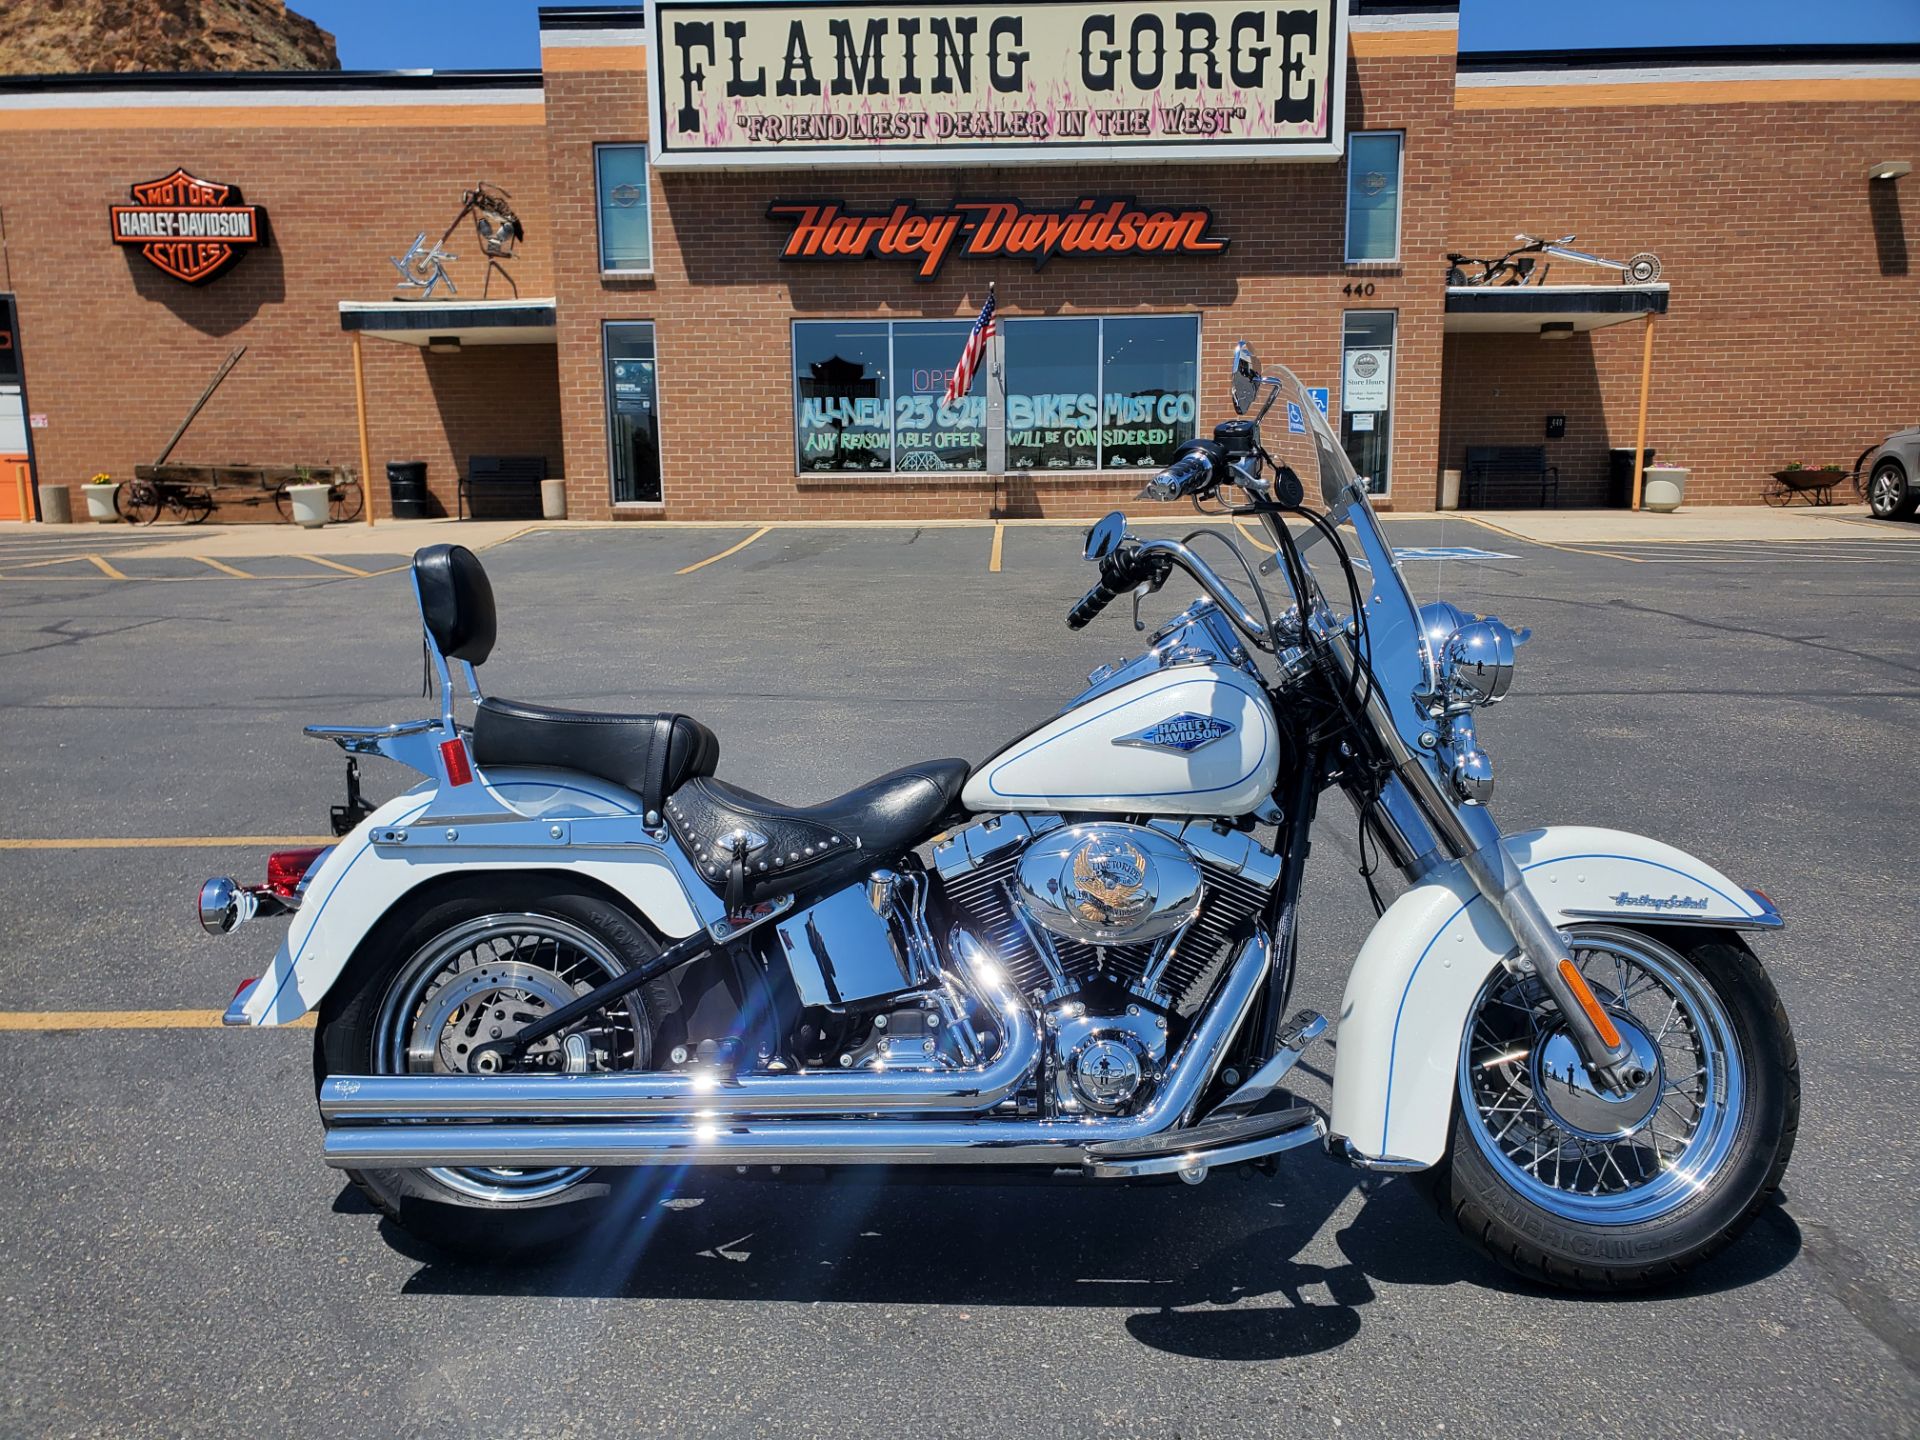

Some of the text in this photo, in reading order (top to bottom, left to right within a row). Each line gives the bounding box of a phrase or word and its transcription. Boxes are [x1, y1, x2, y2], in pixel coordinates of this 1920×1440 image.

[673, 9, 1319, 134] FLAMING GORGE
[736, 102, 1247, 144] "FRIENDLIEST DEALER IN THE WEST"
[147, 177, 218, 206] MOTOR
[118, 212, 250, 237] HARLEY-DAVIDSON
[769, 199, 1231, 277] Harley-Davidson
[153, 243, 221, 274] CYCLES
[1342, 282, 1376, 298] 440
[914, 369, 956, 391] OPE
[896, 395, 934, 431] 23
[1006, 393, 1098, 430] BIKES
[1103, 392, 1157, 426] MUST
[1157, 393, 1196, 425] GO
[804, 432, 838, 452] ANY
[935, 432, 984, 449] OFFER
[1007, 430, 1045, 448] WILL
[1045, 431, 1062, 444] BE
[1153, 727, 1222, 745] DAVIDSON
[1480, 1186, 1636, 1260] AMERICAN
